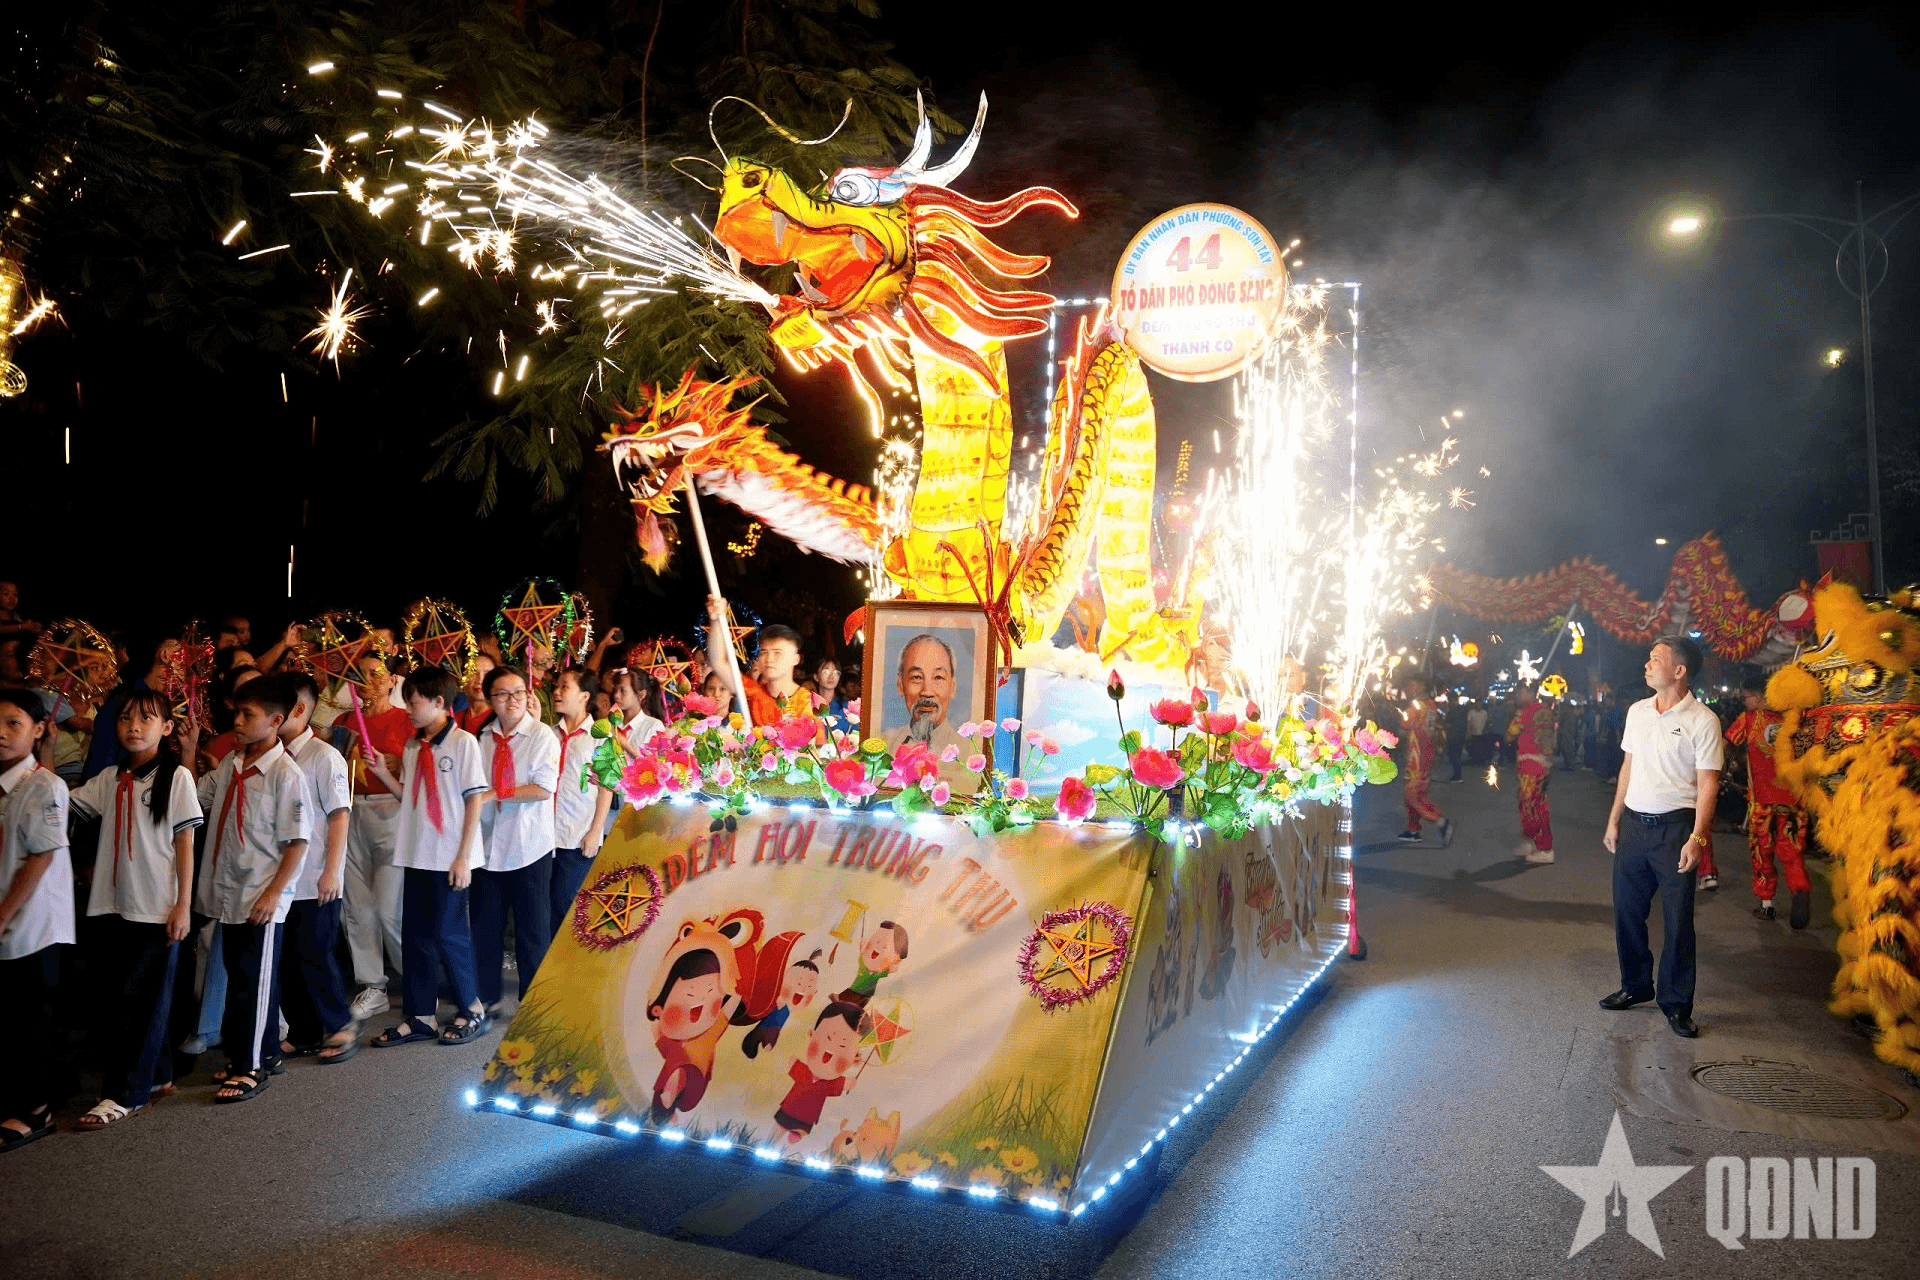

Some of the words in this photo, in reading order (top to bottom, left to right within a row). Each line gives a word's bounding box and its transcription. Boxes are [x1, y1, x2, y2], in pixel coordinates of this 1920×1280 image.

[1131, 239, 1151, 261] BAN
[1147, 218, 1176, 242] NHÂN
[1177, 210, 1199, 226] DÂN
[1166, 233, 1223, 272] 44
[661, 827, 737, 895] ĐÊM
[826, 822, 943, 884] TRUNG
[938, 857, 1018, 931] THU
